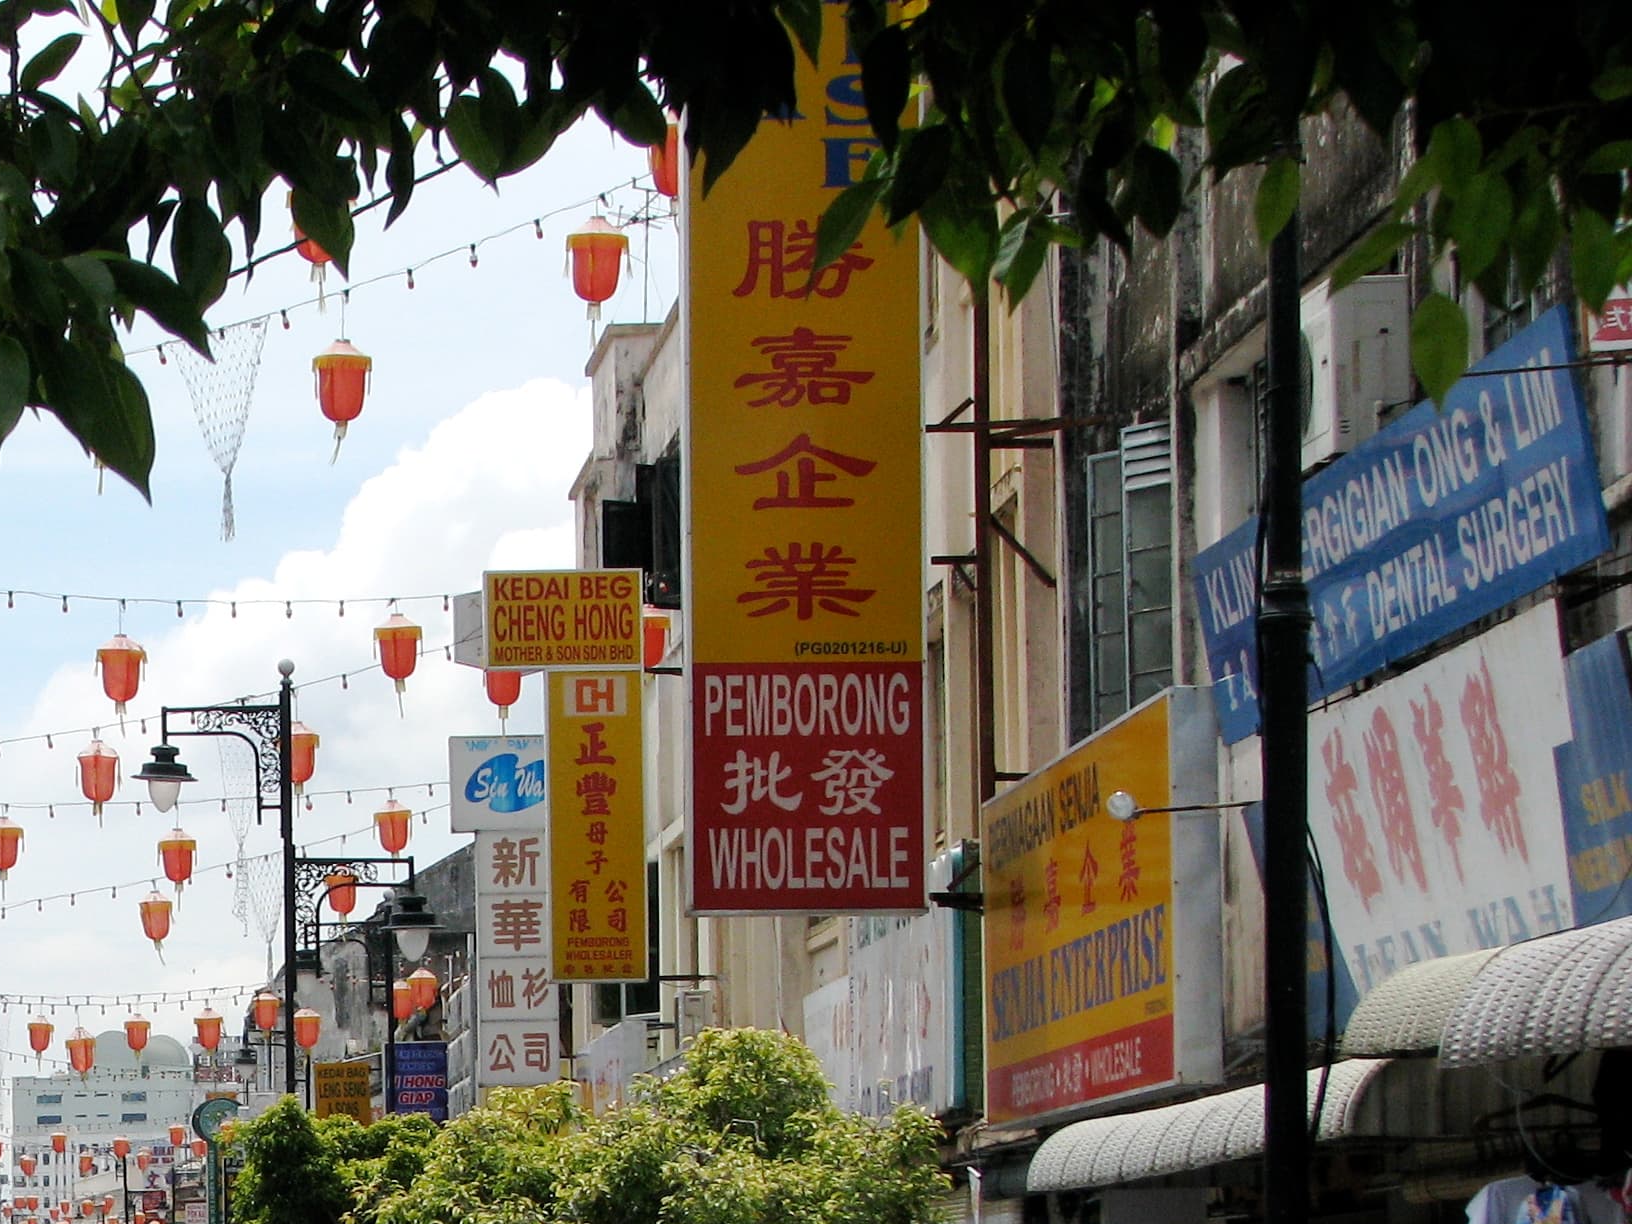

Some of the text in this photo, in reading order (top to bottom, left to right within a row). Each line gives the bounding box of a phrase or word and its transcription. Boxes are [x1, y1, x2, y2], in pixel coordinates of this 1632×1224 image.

[732, 218, 878, 621] 勝嘉企業
[1301, 451, 1410, 582] ERGIGIAN
[1413, 408, 1478, 507] ONG
[1481, 390, 1504, 467] &
[1504, 347, 1562, 450] LIM
[1368, 532, 1458, 641] DENTAL
[1458, 455, 1577, 592] SURGERY
[493, 575, 631, 602] KEDAI BEG
[493, 604, 633, 641] CHENG HONG
[494, 645, 633, 663] MOTHER & SON SDN BHD
[704, 674, 909, 737] PEMBORONG
[474, 767, 507, 798] Sin
[721, 749, 894, 815] 批發
[709, 826, 909, 890] WHOLESALE
[491, 837, 543, 951] 新華
[566, 950, 633, 961] WHOLESALER
[567, 937, 630, 948] PEMBORONG
[1050, 903, 1166, 1021] ENTERPRISE
[488, 968, 548, 1010] 恤衫
[489, 1033, 552, 1073] 公司
[1091, 1037, 1141, 1085] WHOLESALE
[399, 1091, 435, 1105] GIAP
[404, 1075, 445, 1089] HONG
